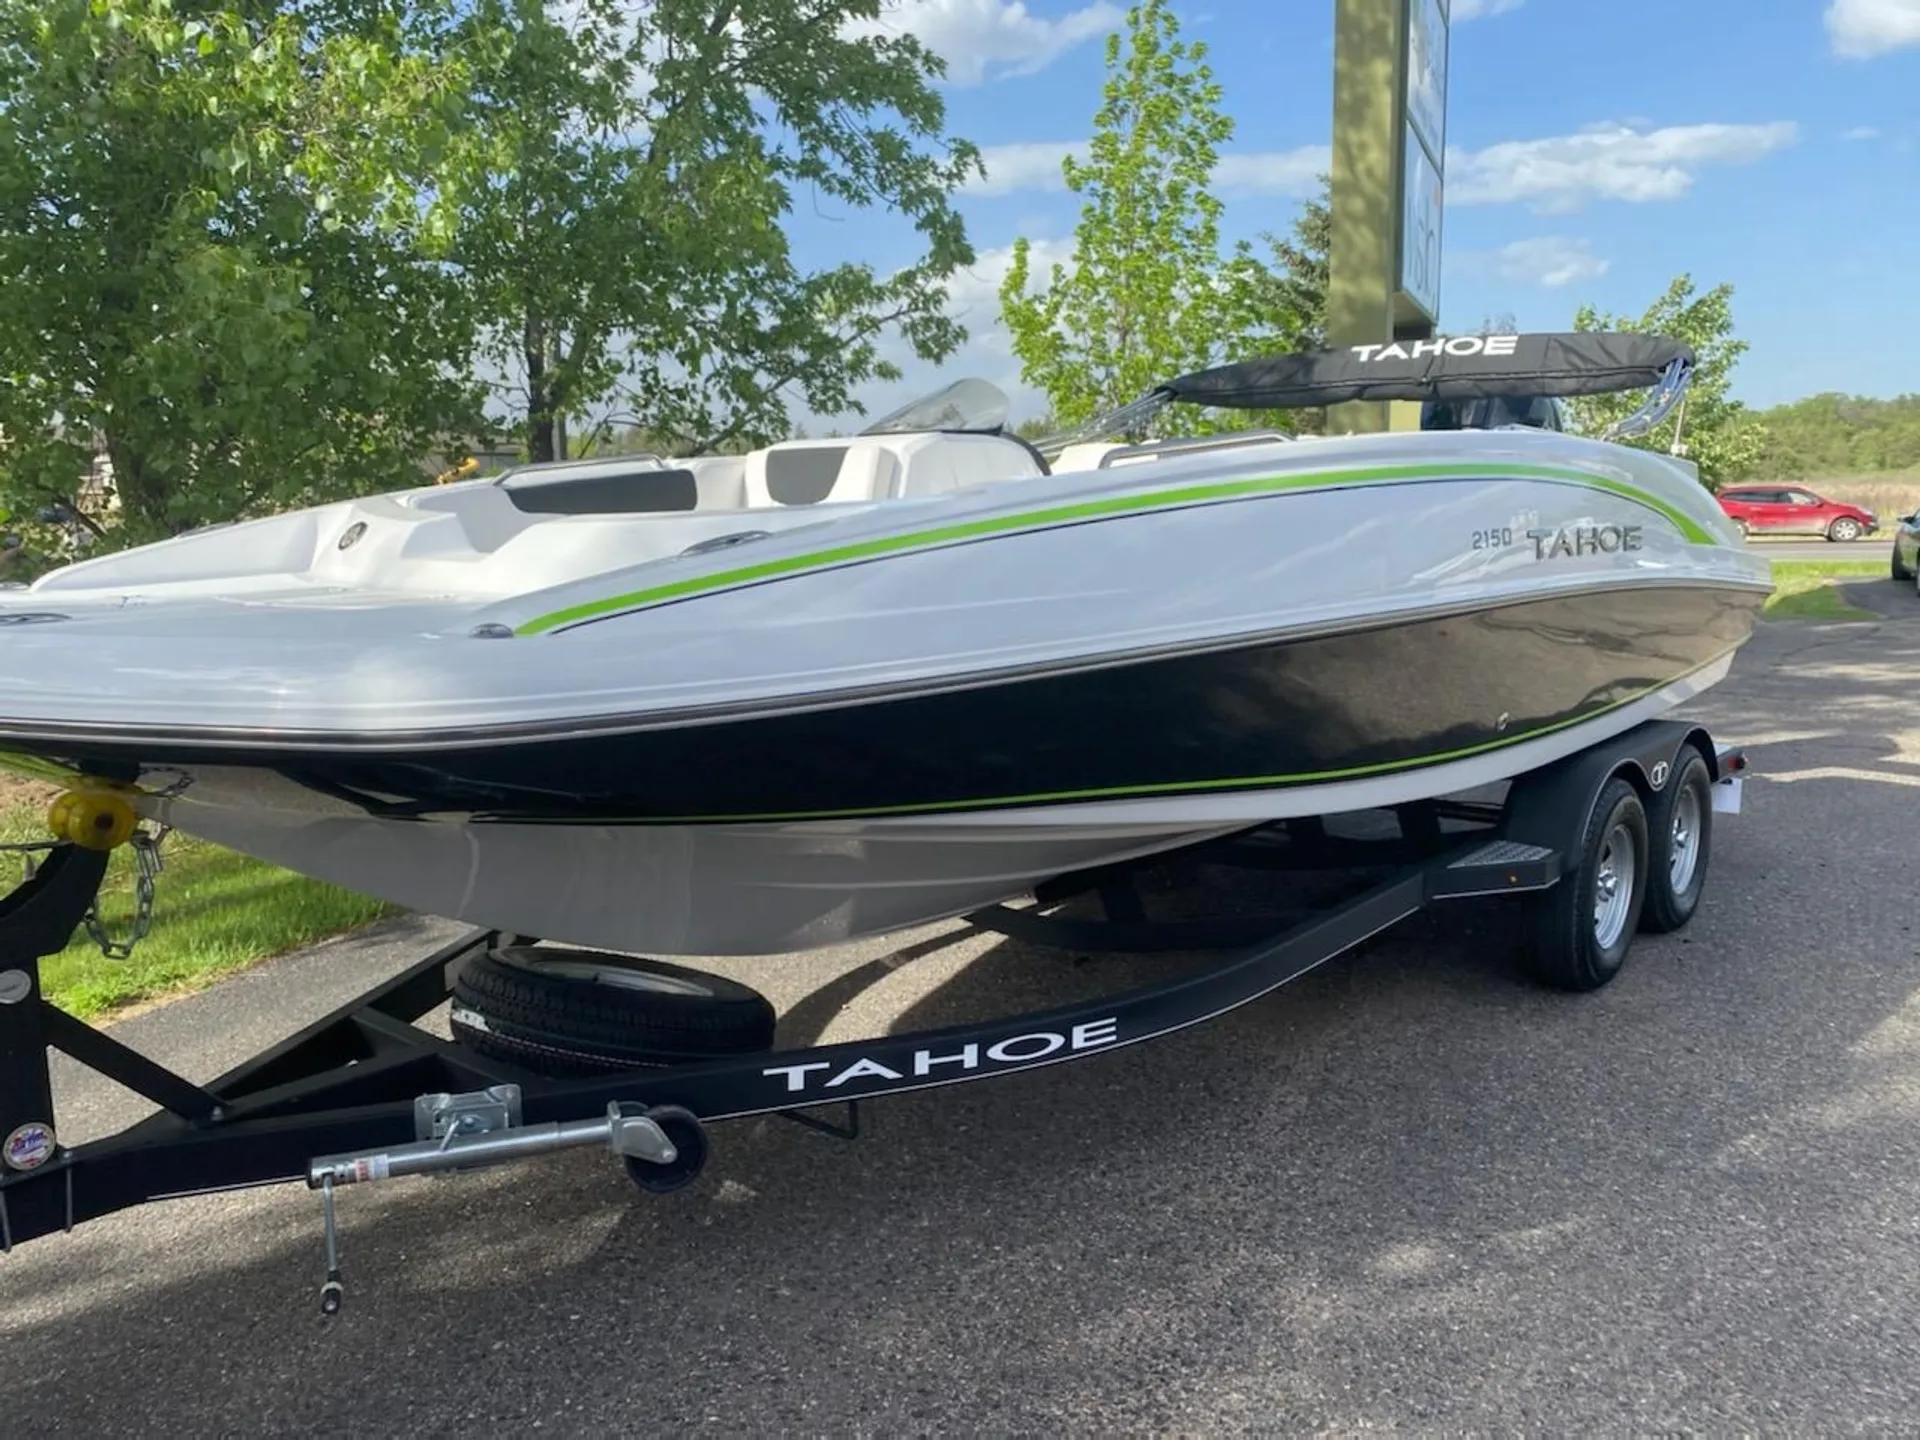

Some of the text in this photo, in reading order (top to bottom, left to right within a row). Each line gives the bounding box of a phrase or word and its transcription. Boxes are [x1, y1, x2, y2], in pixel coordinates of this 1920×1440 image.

[1350, 335, 1518, 362] TAHOE
[1471, 526, 1643, 560] 2150 TAHOE
[763, 1017, 1117, 1092] TAHOE
